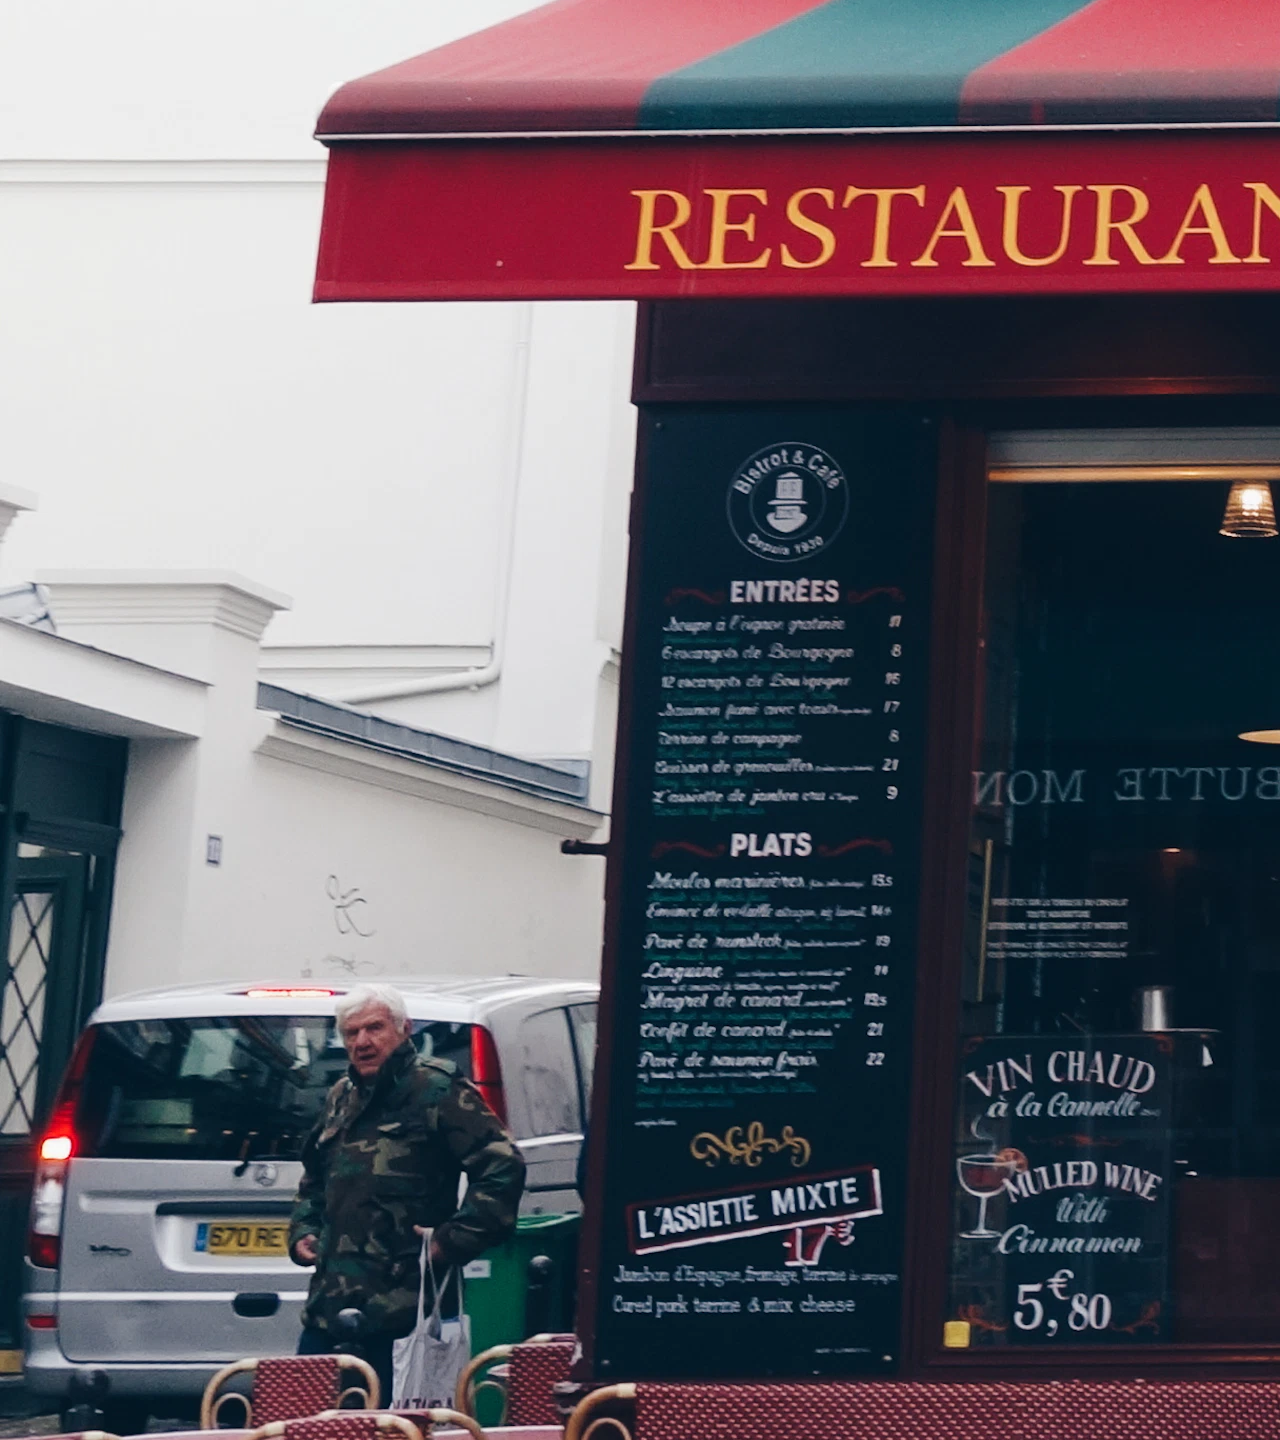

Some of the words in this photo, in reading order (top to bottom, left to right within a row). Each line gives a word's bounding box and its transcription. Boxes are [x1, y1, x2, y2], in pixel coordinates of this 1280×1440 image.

[733, 448, 788, 496] Bistrot
[792, 449, 805, 464] &
[808, 453, 845, 490] Café
[730, 577, 840, 603] ENTRÉES
[886, 785, 899, 800] 9
[730, 832, 813, 858] PLATS
[966, 1054, 1034, 1097] VIN
[1047, 1050, 1156, 1093] CHAUD
[1015, 1092, 1042, 1118] la
[1047, 1091, 1143, 1118] Cannelle
[1003, 1160, 1098, 1203] MULLED
[1104, 1162, 1162, 1201] WINE
[637, 1194, 760, 1239] L'ASSIETTE
[771, 1177, 860, 1217] MIXTE
[1055, 1192, 1109, 1223] With
[998, 1223, 1143, 1255] Cinnamon
